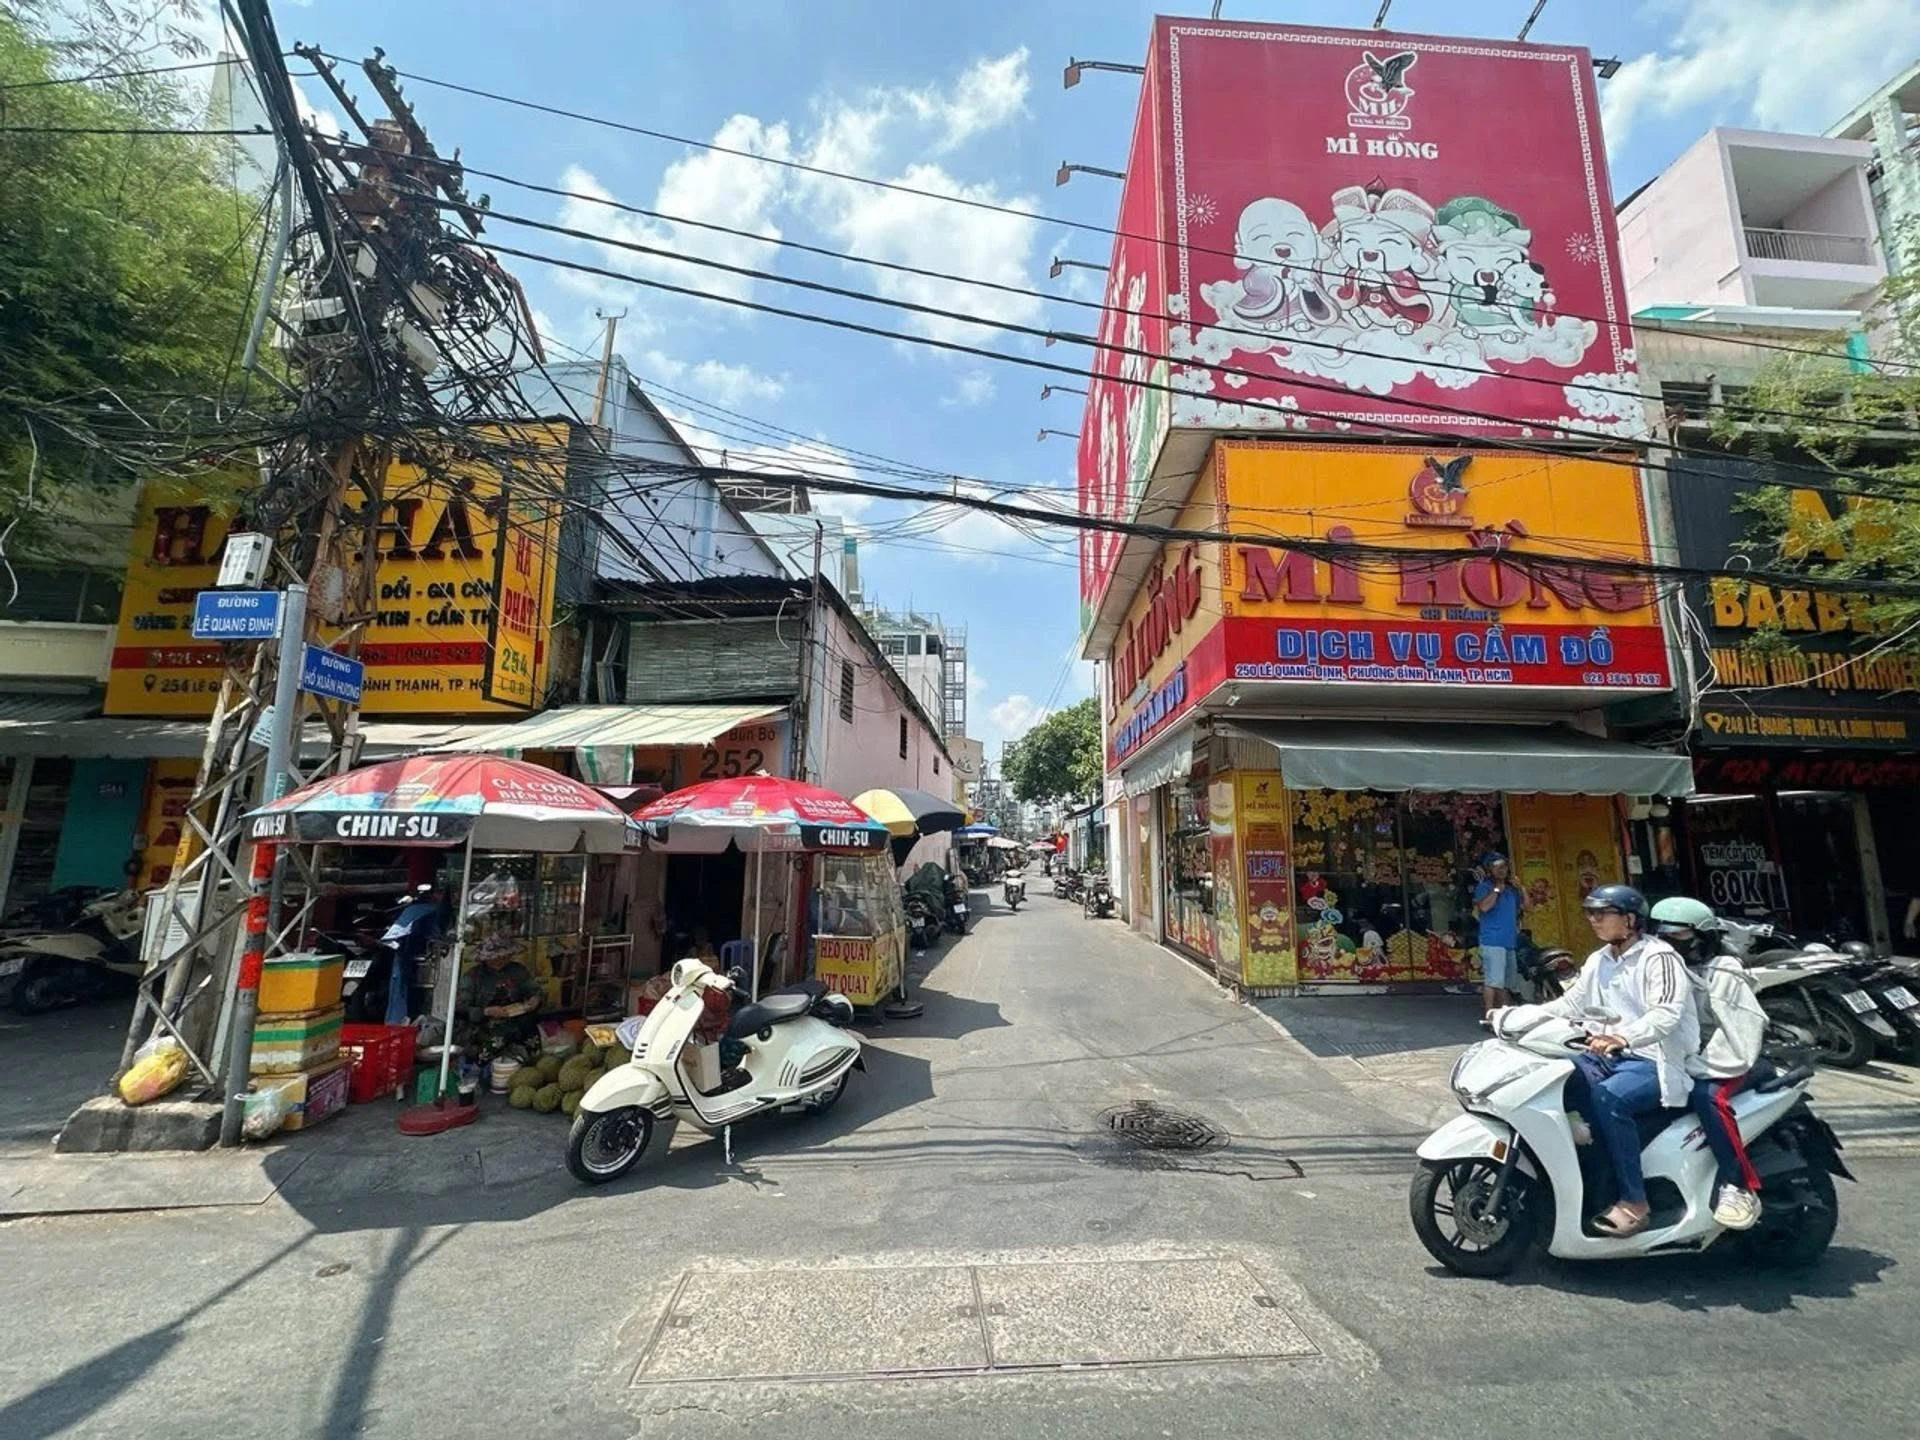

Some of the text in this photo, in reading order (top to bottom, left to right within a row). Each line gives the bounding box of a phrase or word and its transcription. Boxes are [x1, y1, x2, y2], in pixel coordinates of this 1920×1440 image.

[217, 594, 260, 608] ĐƯỜNG
[196, 613, 209, 632] LÊ
[211, 617, 247, 632] QUANG
[247, 617, 274, 635] ĐỊNH
[1277, 628, 1375, 665] DỊCH
[1387, 631, 1442, 669] VỤ
[501, 648, 527, 676] 254
[1235, 664, 1257, 678] 250
[1258, 662, 1273, 678] LÊ
[1273, 664, 1313, 680] QUANG
[1348, 664, 1395, 680] PHƯỜNG
[1484, 668, 1513, 683] HCM
[700, 748, 764, 778] 252
[336, 815, 440, 838] CHIN-SU
[819, 829, 870, 848] CHIN-SU
[842, 942, 872, 963] QUAY
[839, 973, 869, 994] QUAY
